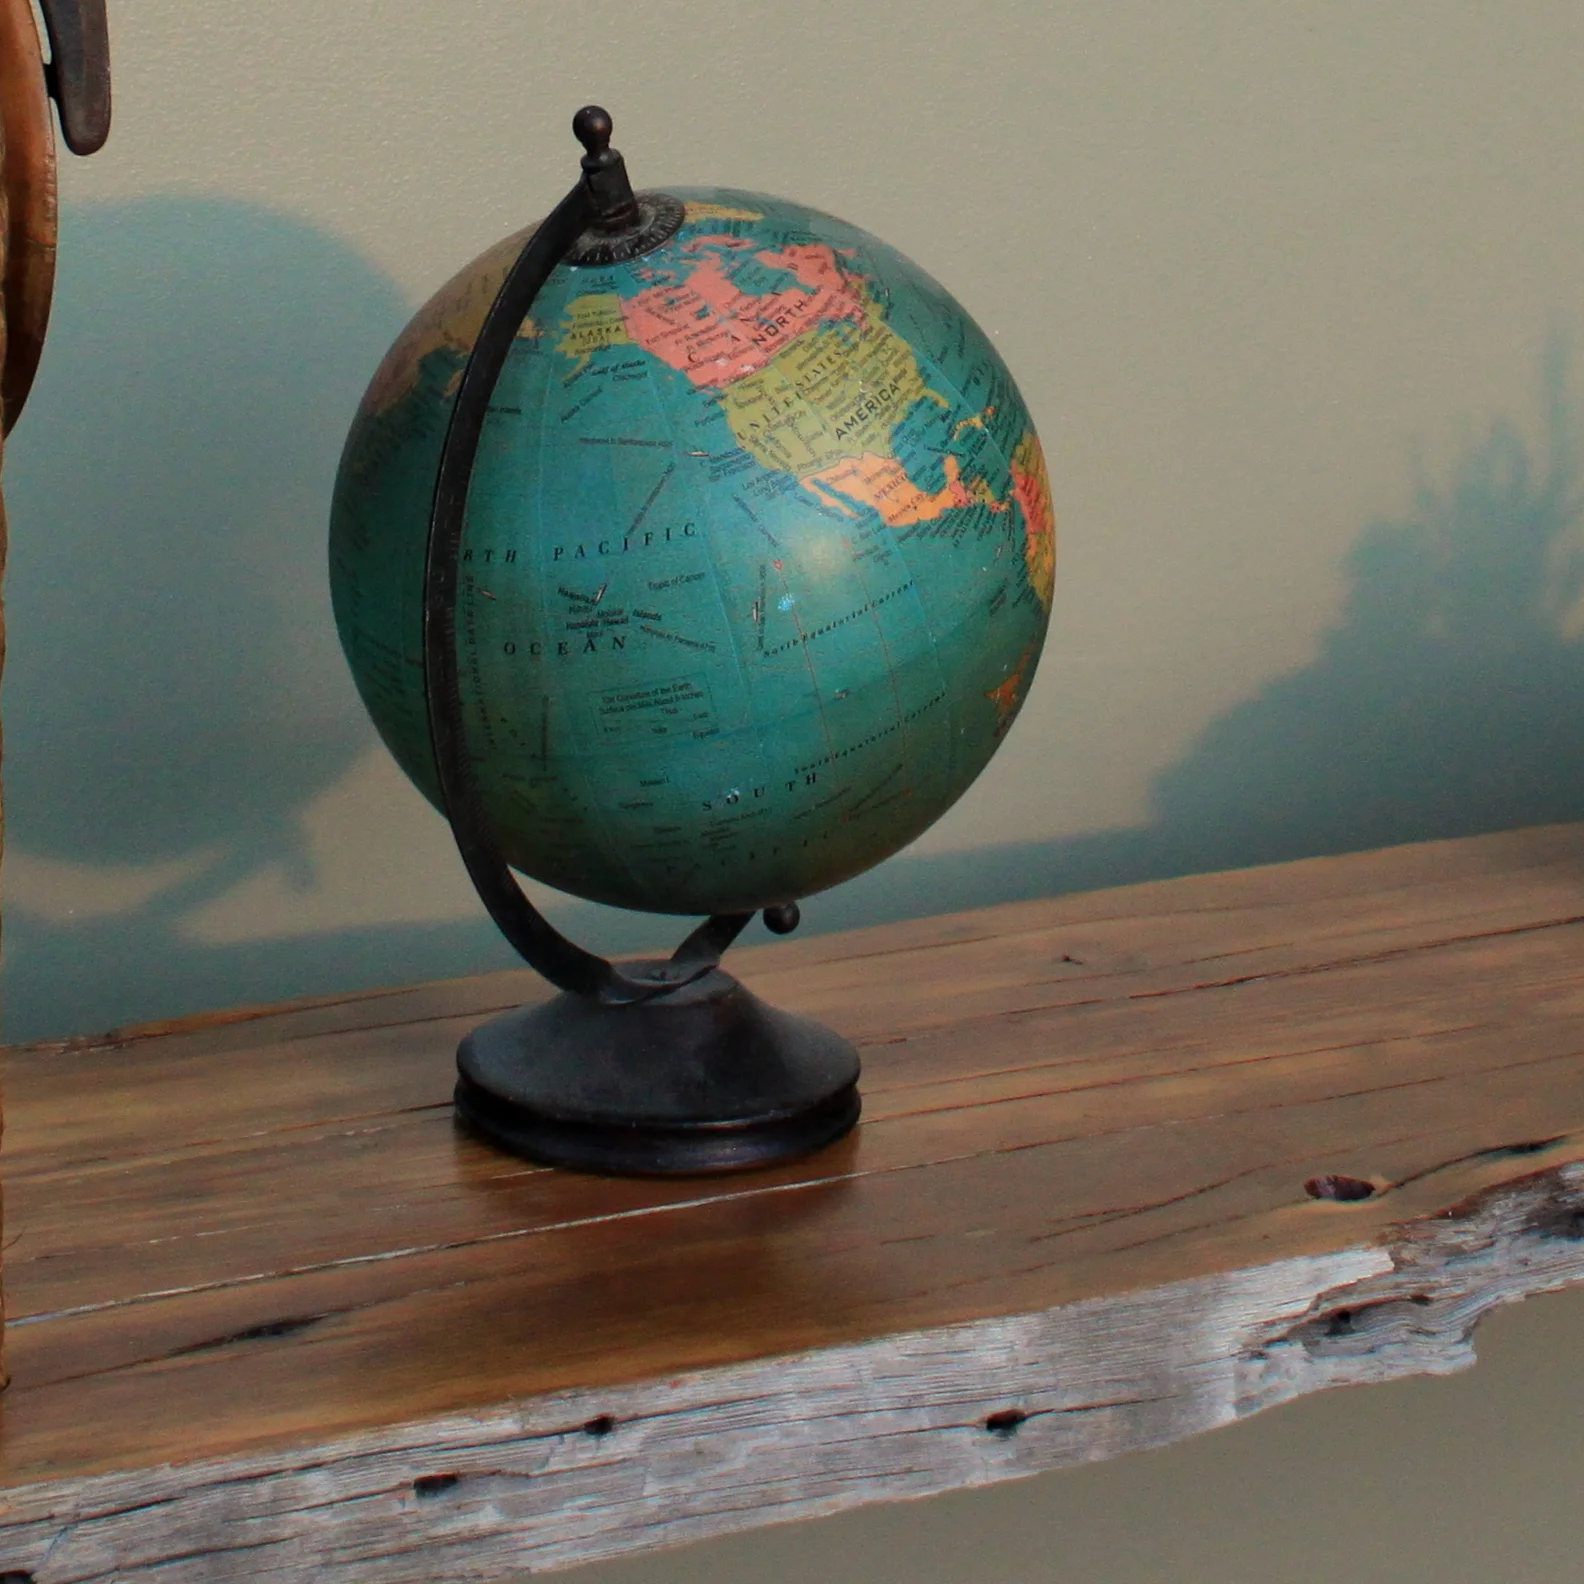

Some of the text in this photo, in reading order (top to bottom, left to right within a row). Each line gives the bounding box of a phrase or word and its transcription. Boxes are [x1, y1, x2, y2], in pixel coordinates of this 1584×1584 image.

[570, 324, 621, 341] ALASKA
[751, 299, 807, 346] NORTH
[835, 383, 900, 441] AMERICA
[874, 471, 909, 500] MEXICO
[552, 522, 696, 561] PACIFIC
[763, 638, 800, 657] North
[869, 578, 913, 609] Current
[504, 635, 627, 656] OCEAN
[701, 771, 818, 812] SOUTH
